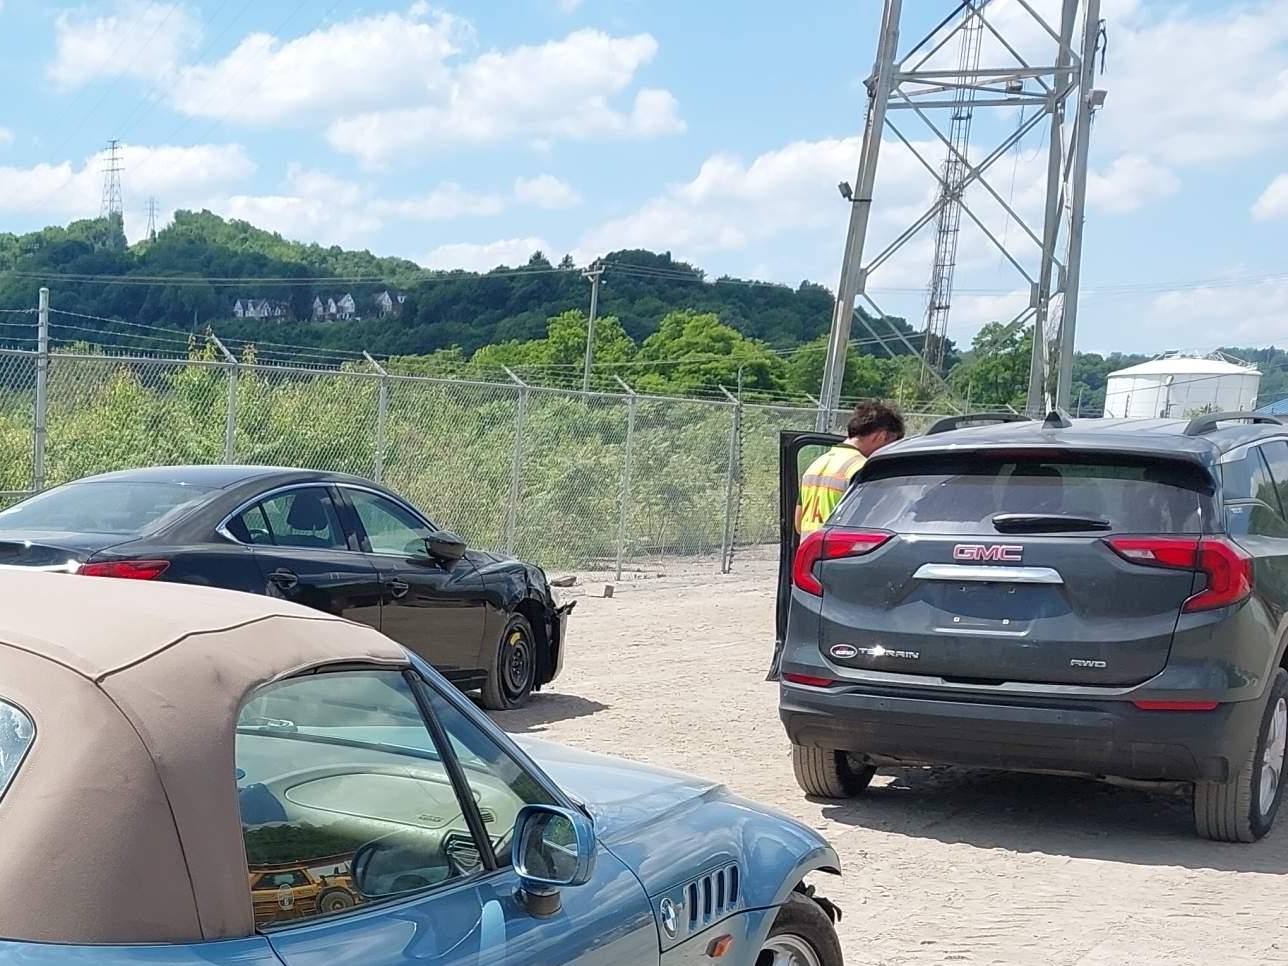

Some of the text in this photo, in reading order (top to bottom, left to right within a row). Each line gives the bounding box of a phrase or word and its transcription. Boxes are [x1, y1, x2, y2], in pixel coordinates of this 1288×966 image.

[953, 544, 1023, 561] GMC
[858, 647, 920, 659] TERAIN
[1070, 659, 1106, 668] AWD
